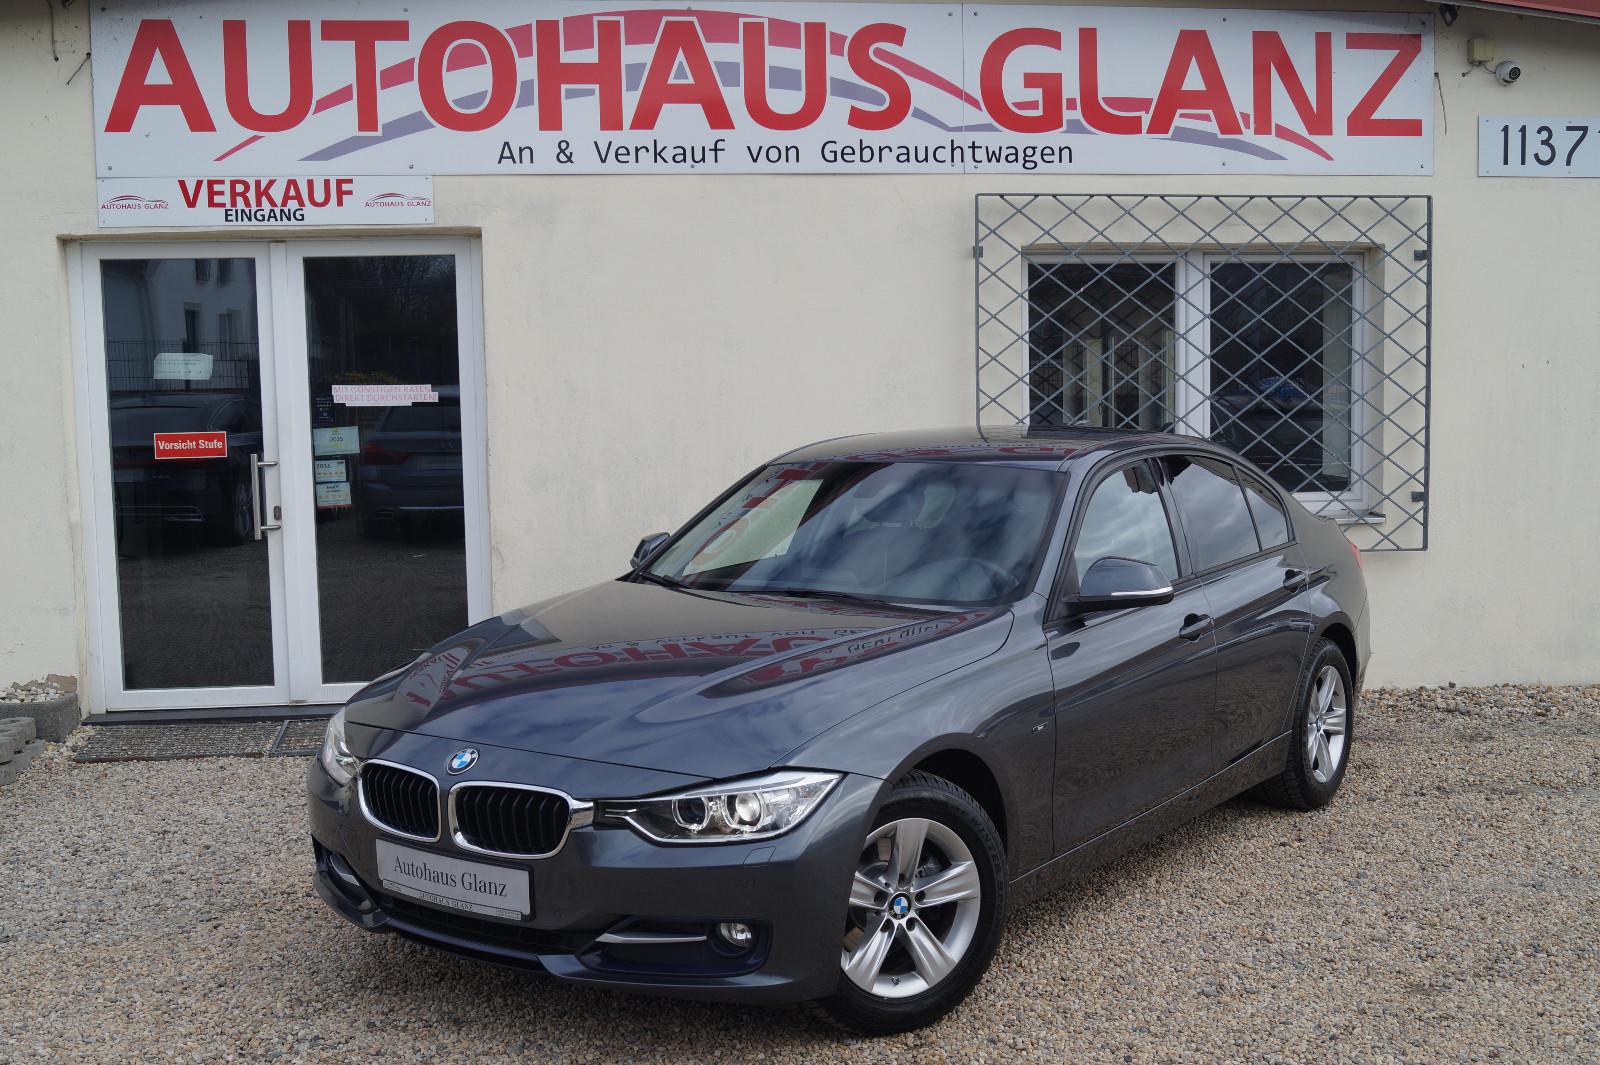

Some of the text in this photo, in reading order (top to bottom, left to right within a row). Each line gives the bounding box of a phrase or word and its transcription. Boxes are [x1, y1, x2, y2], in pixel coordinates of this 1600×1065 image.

[104, 19, 1423, 137] AUTOHAUS GLANZ
[497, 138, 1074, 169] An & Verkauf von Gebrauchtwagen
[1500, 124, 1600, 166] 1137
[178, 178, 353, 209] VERKAUF
[224, 208, 305, 223] EINGANG
[158, 439, 223, 450] Vorsicht Stufe
[393, 855, 508, 898] Autohaus Glanz
